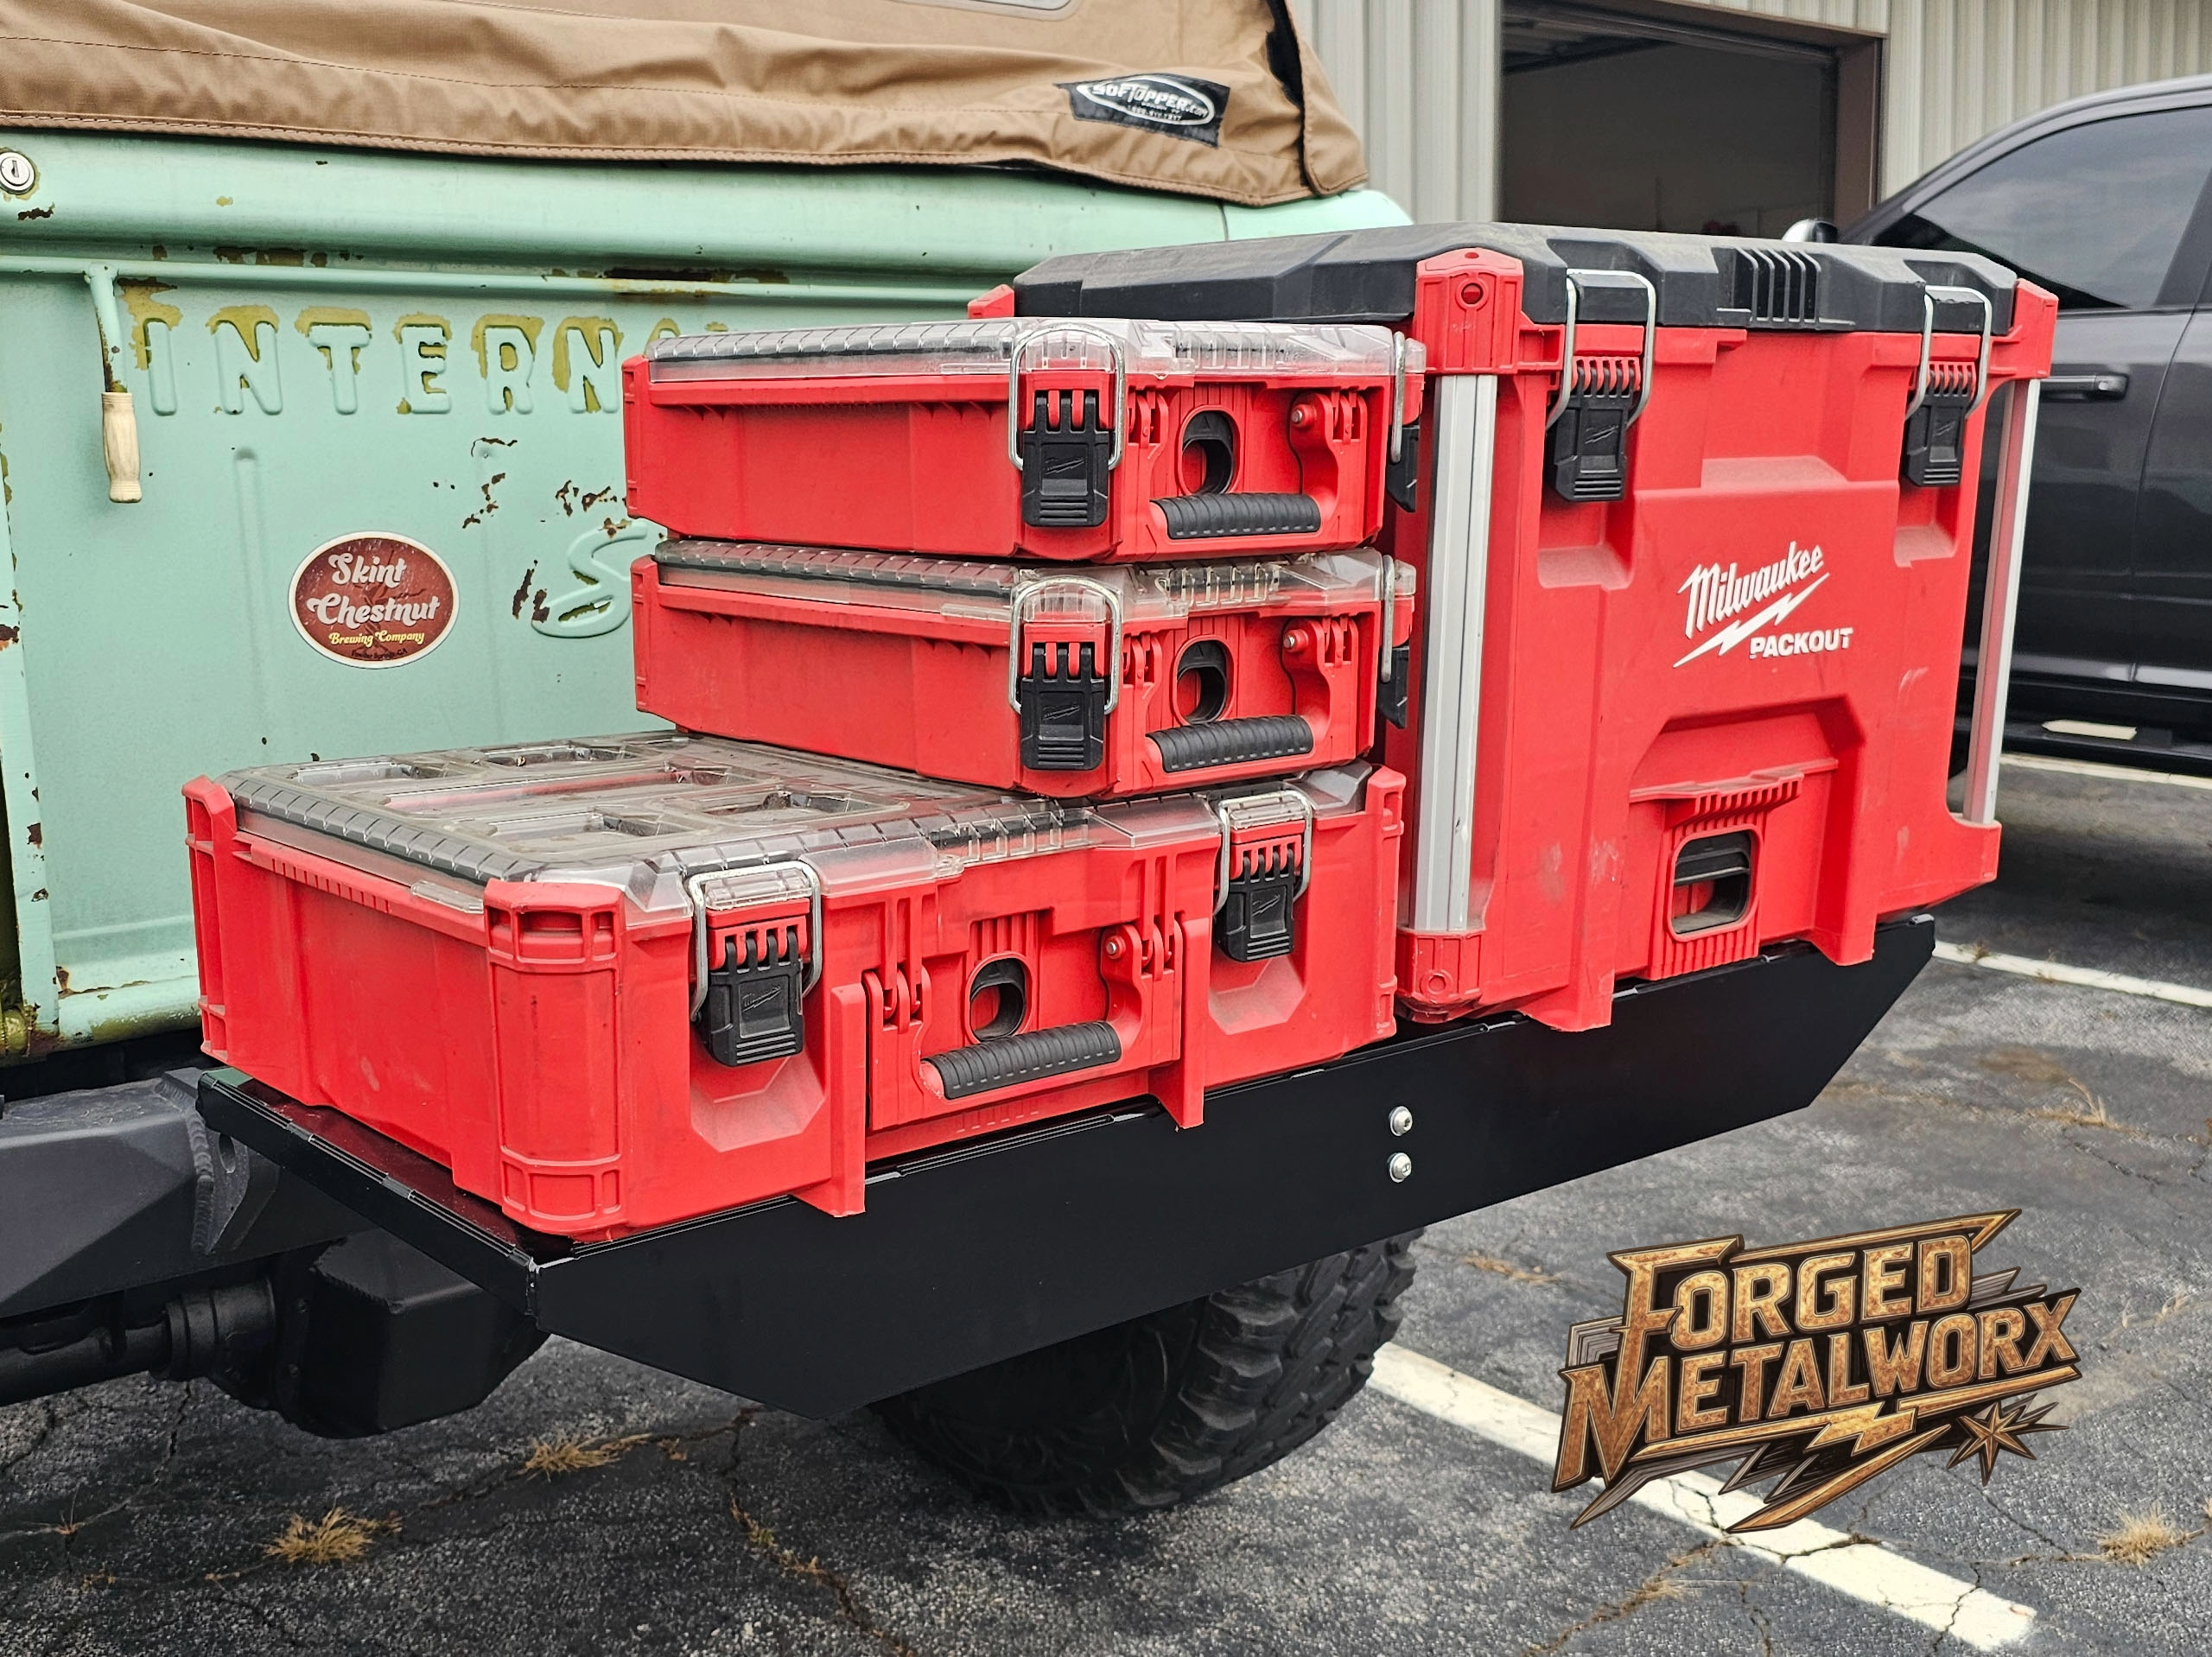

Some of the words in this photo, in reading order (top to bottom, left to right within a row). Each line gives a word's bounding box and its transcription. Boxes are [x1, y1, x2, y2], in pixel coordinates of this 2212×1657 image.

[143, 318, 680, 416] INTERN
[328, 552, 407, 588] Skint
[1677, 541, 1825, 639] Milwaukee
[307, 593, 441, 629] Chestnut
[328, 632, 373, 647] Brewing
[375, 630, 425, 644] Company
[1749, 627, 1853, 659] PACKOUT
